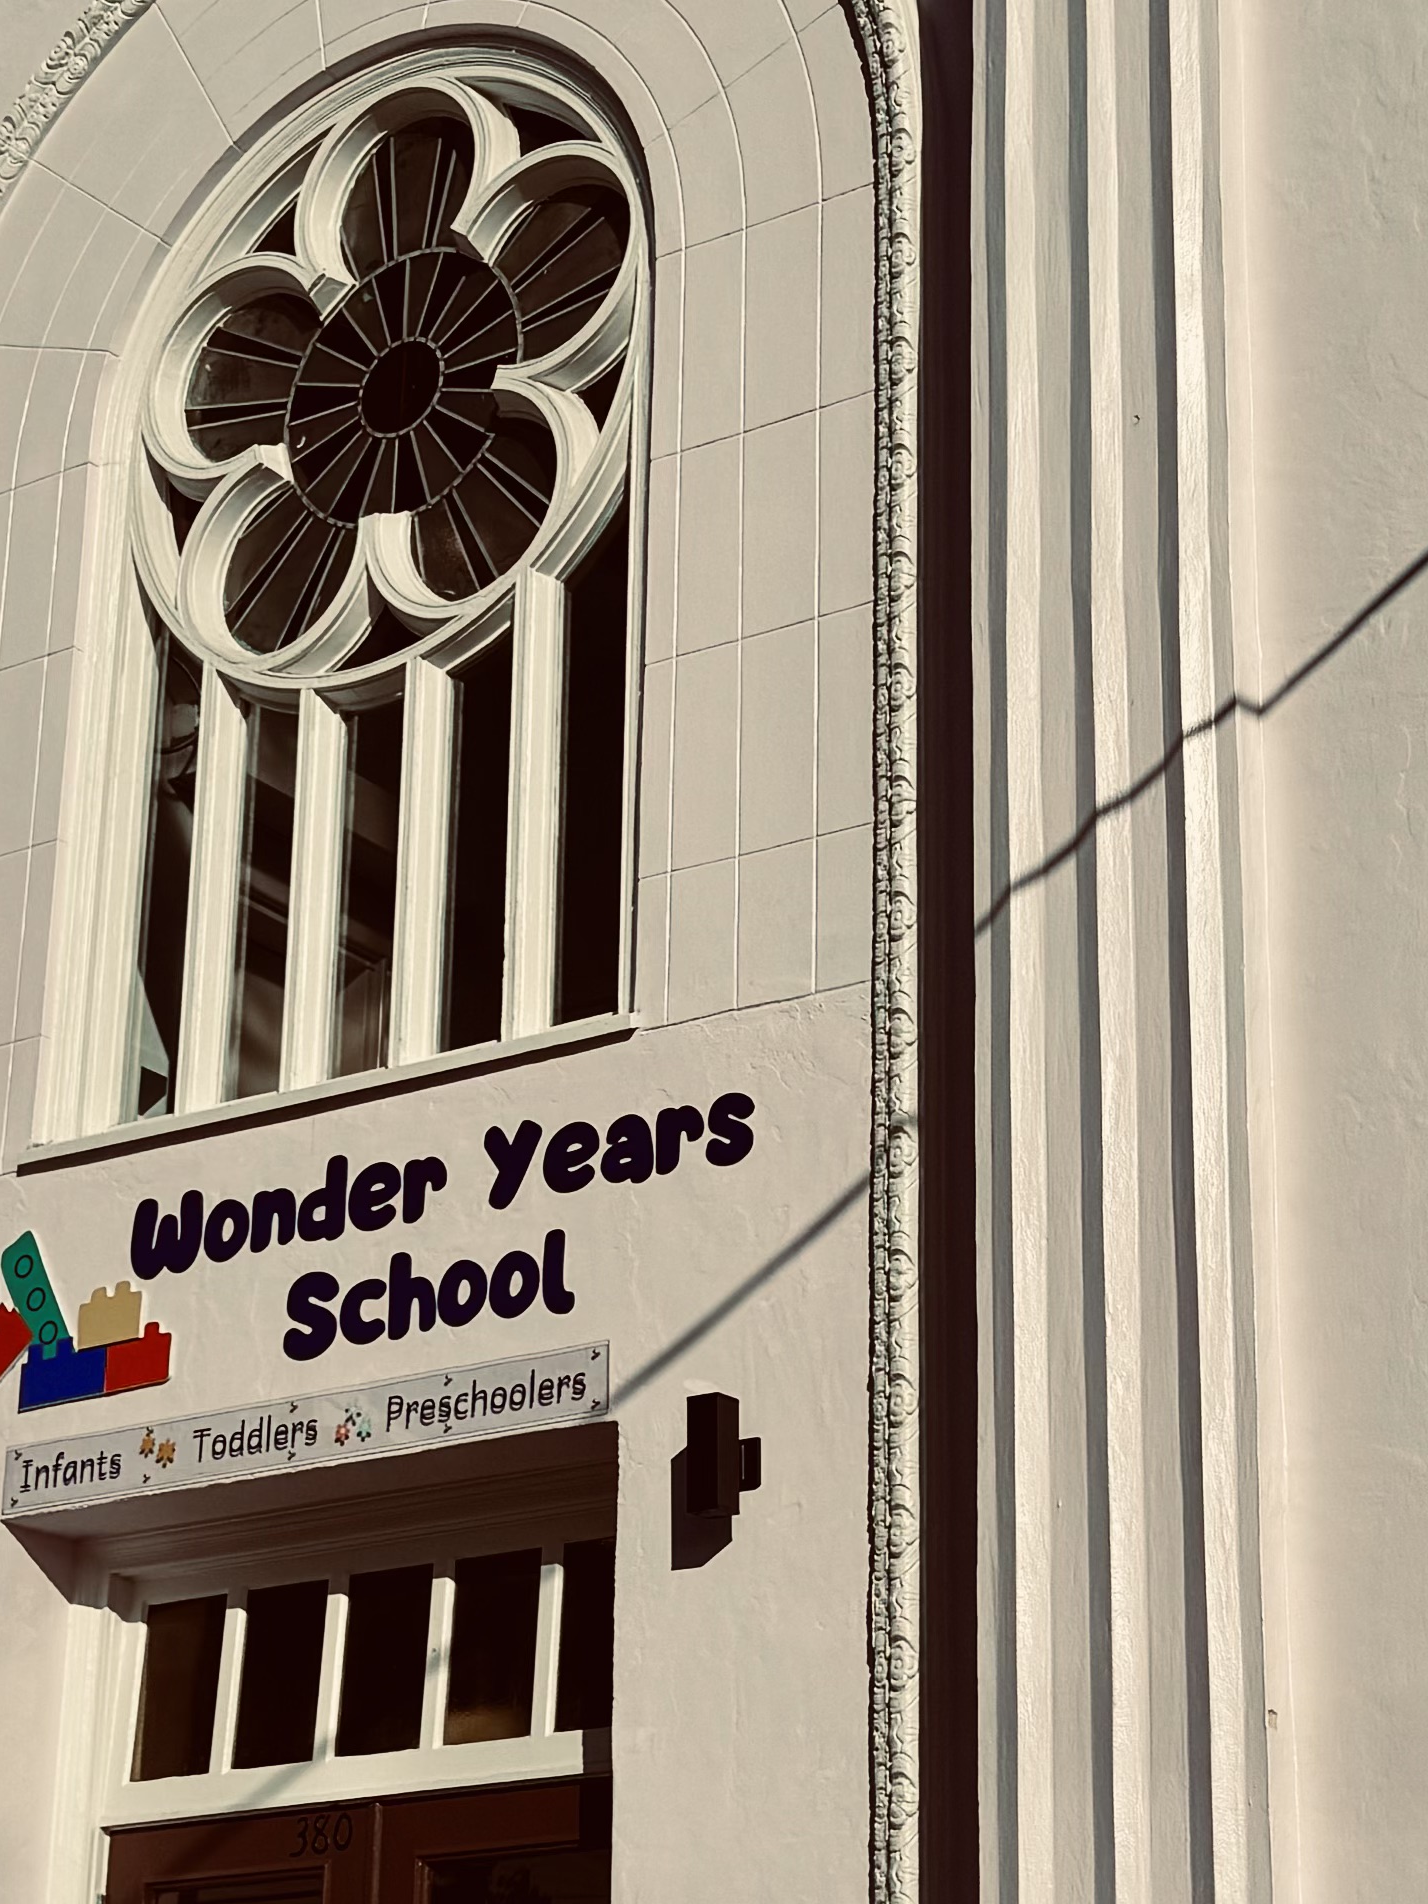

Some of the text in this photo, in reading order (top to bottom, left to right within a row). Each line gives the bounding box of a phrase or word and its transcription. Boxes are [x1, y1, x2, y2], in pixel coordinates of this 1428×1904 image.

[131, 1092, 756, 1281] Wonder Years
[282, 1229, 576, 1362] School
[19, 1369, 588, 1494] Infants Toddlers Preschoolers
[288, 1812, 353, 1858] 380
